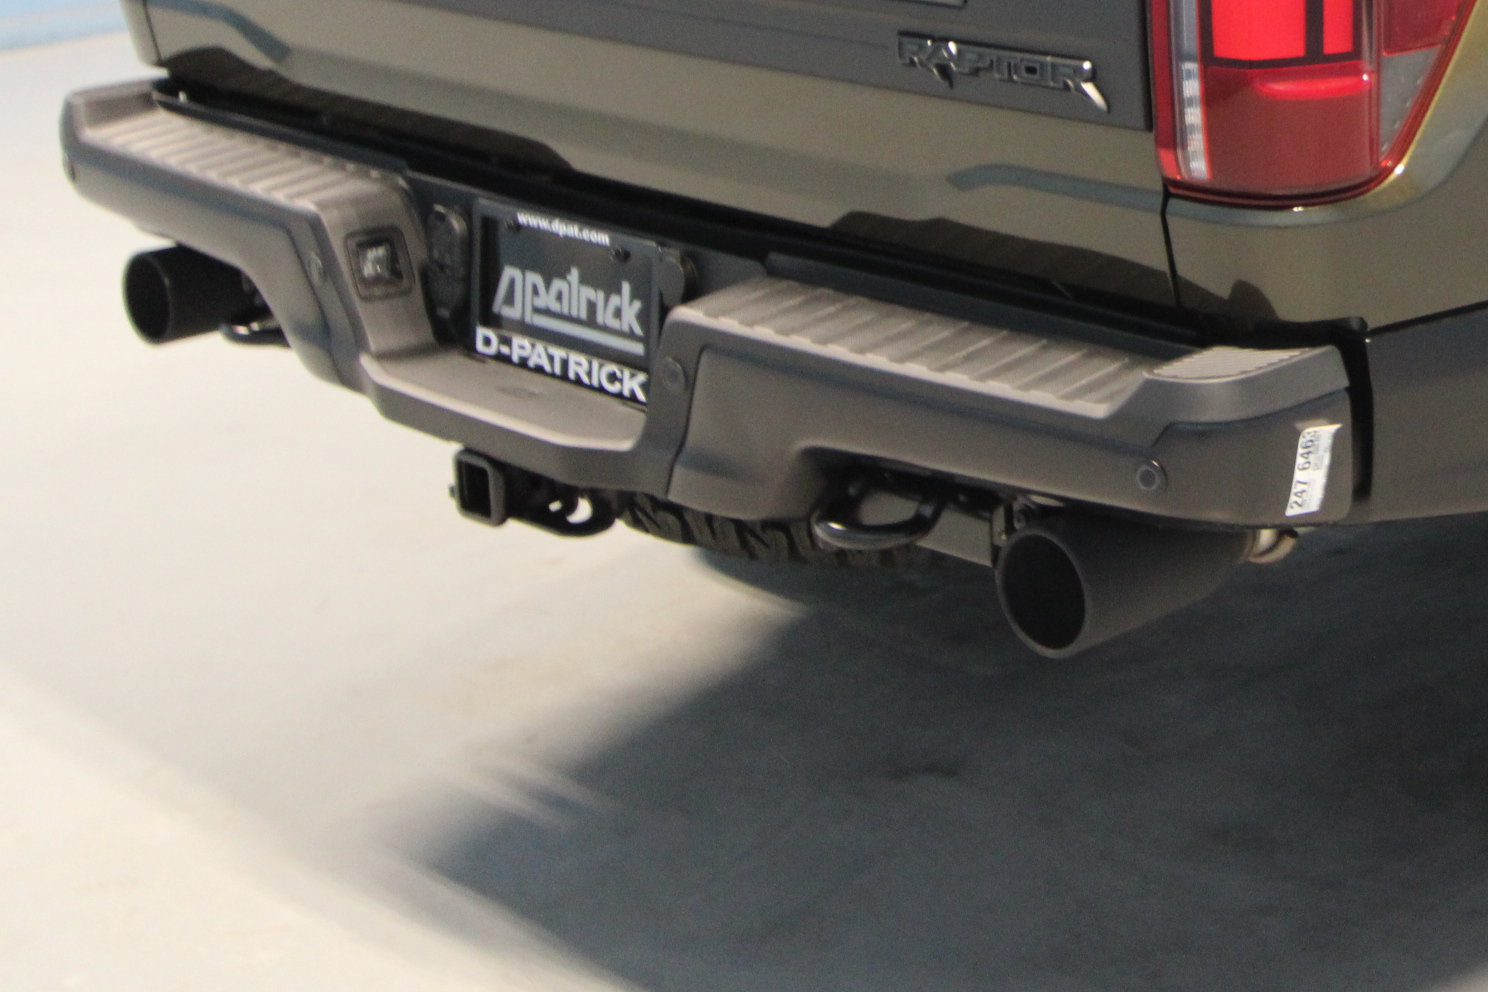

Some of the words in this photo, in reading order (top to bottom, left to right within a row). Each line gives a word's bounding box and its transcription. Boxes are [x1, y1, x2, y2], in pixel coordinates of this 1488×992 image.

[897, 30, 1110, 115] RAPTOR
[516, 211, 611, 248] www.dpat.com
[475, 325, 648, 403] D-PATRICK
[1289, 479, 1309, 510] 247
